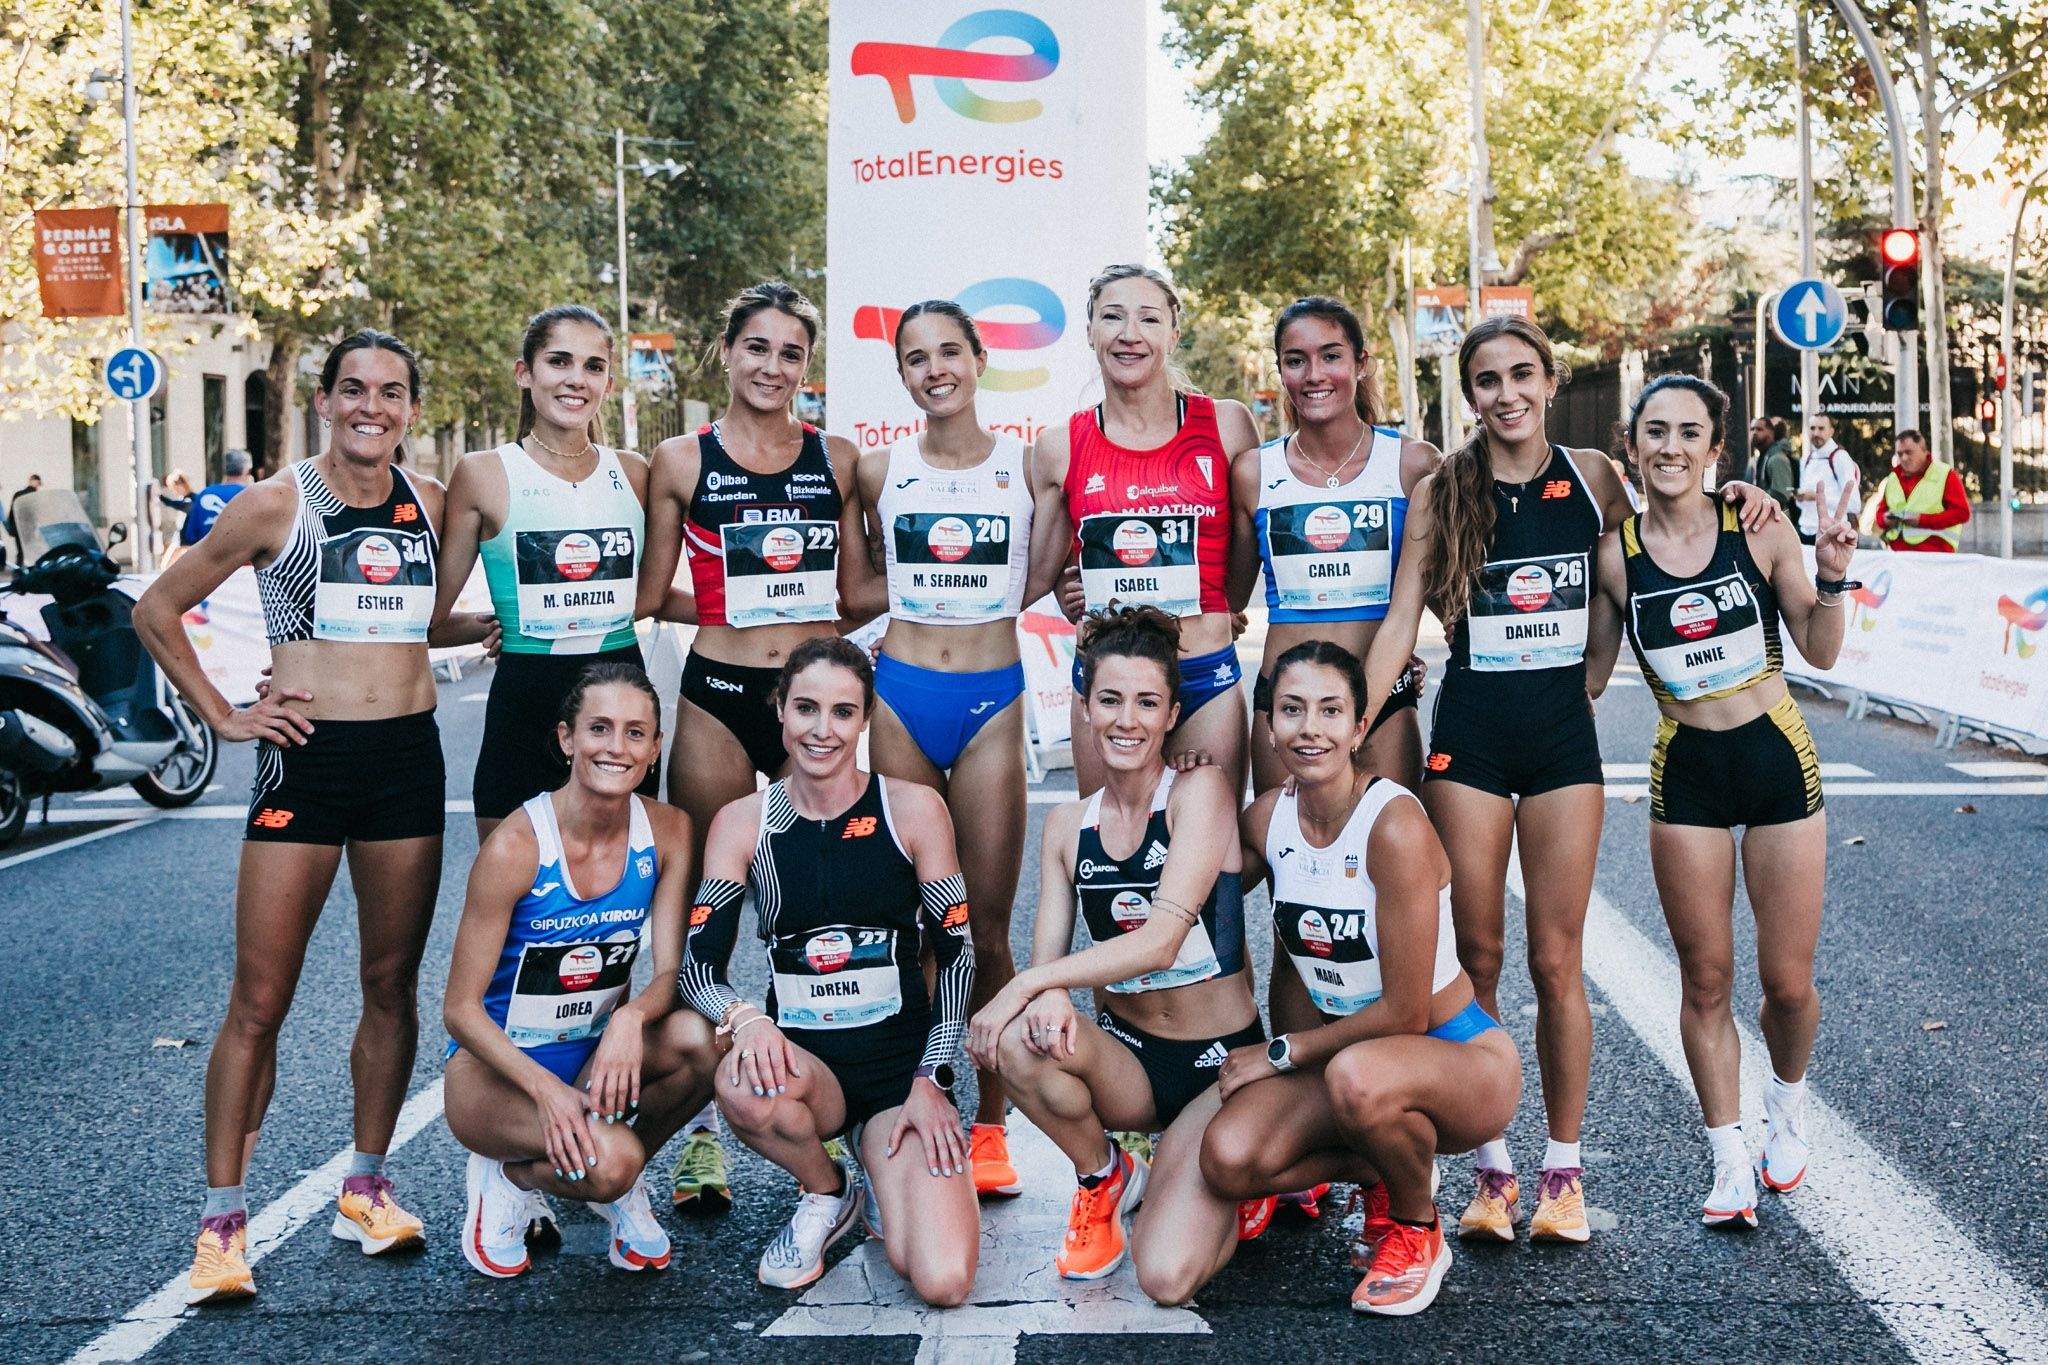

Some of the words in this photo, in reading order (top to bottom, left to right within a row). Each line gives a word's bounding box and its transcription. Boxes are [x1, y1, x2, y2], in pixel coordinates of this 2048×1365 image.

[853, 149, 1063, 183] TotalEnergies
[42, 226, 111, 242] FERNÁN
[43, 242, 111, 255] GÓMEZ
[708, 474, 748, 488] Bilbao
[708, 492, 757, 502] Guedan
[793, 485, 832, 495] Bizkaialde
[1140, 484, 1179, 498] alquiber
[766, 508, 801, 522] BM
[1122, 505, 1216, 517] MARATHON
[1353, 504, 1384, 528] 29
[806, 526, 833, 550] 22
[976, 517, 1006, 543] 20
[1161, 519, 1189, 544] 31
[402, 538, 428, 564] 34
[601, 531, 631, 557] 25
[1309, 562, 1351, 578] CARLA
[1554, 560, 1583, 588] 26
[913, 573, 927, 587] M.
[930, 574, 988, 588] SERRANO
[1114, 577, 1159, 592] ISABEL
[766, 582, 805, 598] LAURA
[1714, 581, 1748, 611] 30
[357, 595, 403, 611] ESTHER
[543, 594, 559, 608] M.
[563, 591, 615, 607] GARZZIA
[1505, 622, 1560, 640] DANIELA
[1685, 646, 1726, 668] ANNIE
[1143, 855, 1168, 871] adid
[530, 913, 599, 931] GIPUZKOA
[600, 908, 645, 923] KIROLA
[1330, 913, 1360, 941] 24
[858, 931, 888, 946] 27
[606, 944, 638, 966] 21
[1314, 966, 1345, 987] MARÍA
[811, 981, 860, 998] LORENA
[556, 1001, 593, 1019] LOREA
[1111, 1025, 1142, 1049] MAPOMA
[1195, 1058, 1227, 1068] adid
